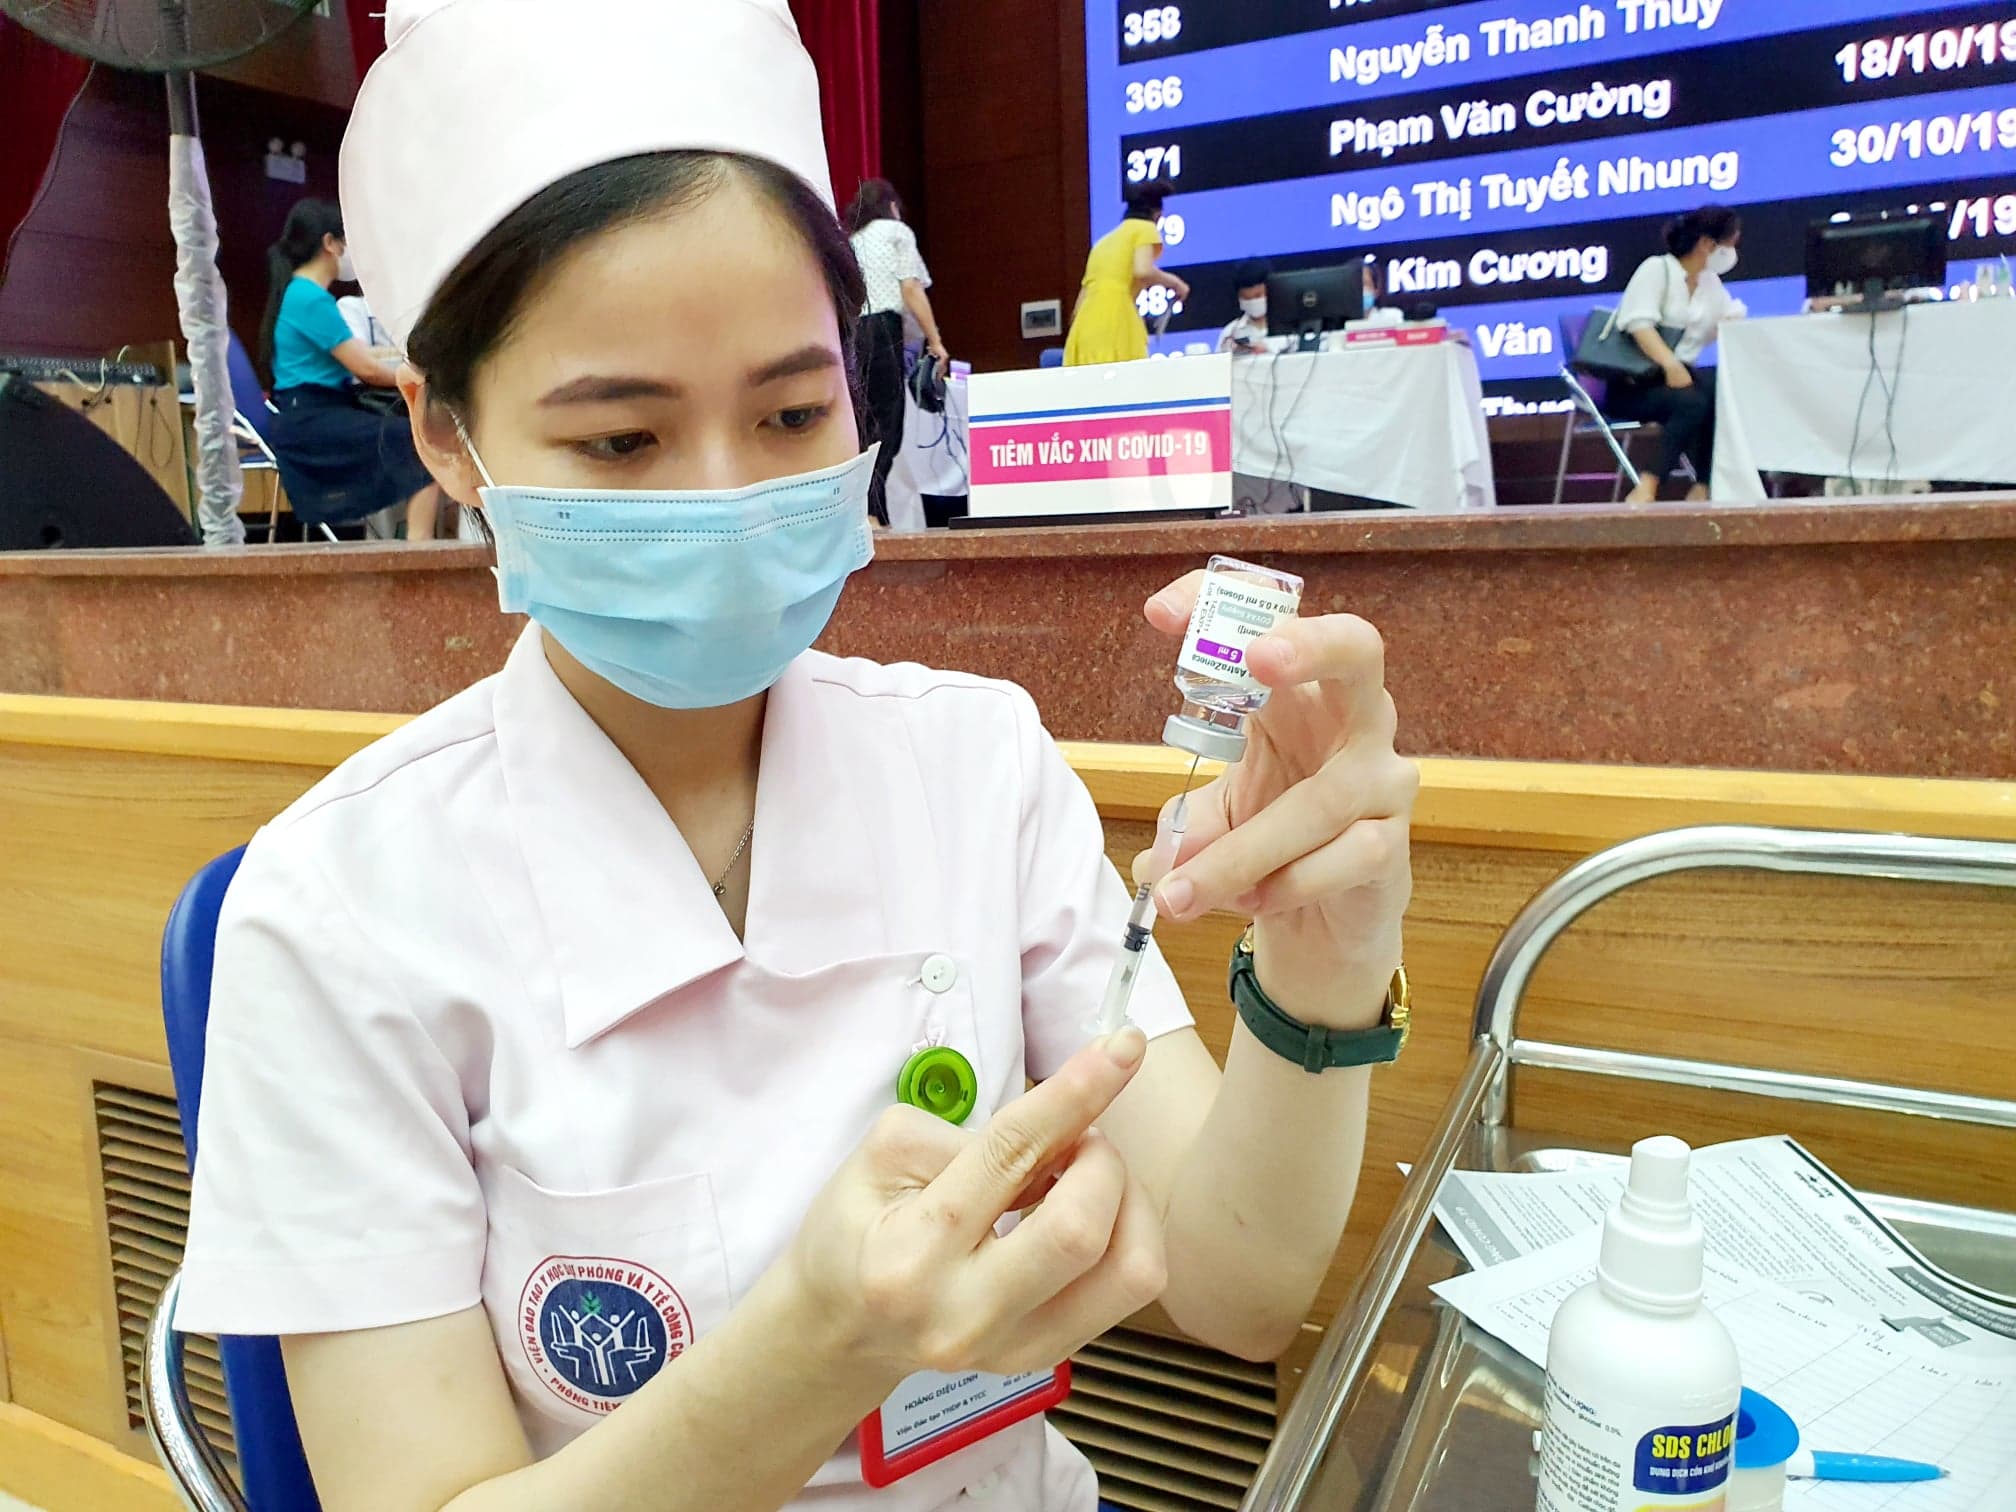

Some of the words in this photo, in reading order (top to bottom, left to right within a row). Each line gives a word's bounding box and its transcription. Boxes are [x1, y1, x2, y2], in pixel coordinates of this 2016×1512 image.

[1123, 6, 1182, 46] 358
[1329, 23, 1470, 86] Nguyễn
[1480, 5, 1605, 56] Thanh
[1125, 75, 1184, 114] 366
[1329, 112, 1434, 158] Phạm
[1440, 99, 1517, 140] Văn
[1525, 79, 1672, 128] Cường
[1127, 144, 1182, 182] 371
[1330, 184, 1405, 231] Ngô
[1412, 178, 1473, 222] Thị
[1480, 157, 1589, 213] Tuyết
[1598, 150, 1739, 198] Nhung
[1386, 254, 1462, 294] Kim
[1469, 244, 1608, 286] Cương
[1476, 319, 1553, 358] Văn
[989, 439, 1034, 468] TIÊM
[1038, 432, 1075, 465] VẮC
[1079, 436, 1113, 463] XIN
[1117, 431, 1208, 460] COVID-19
[1191, 653, 1247, 678] AstraZeneca
[1217, 646, 1230, 656] ml
[1230, 650, 1239, 661] 5
[540, 1274, 549, 1287] Y
[644, 1281, 655, 1294] Y
[550, 1377, 590, 1406] PHÒNG
[958, 1373, 979, 1388] LINH
[1651, 1433, 1692, 1460] SDS
